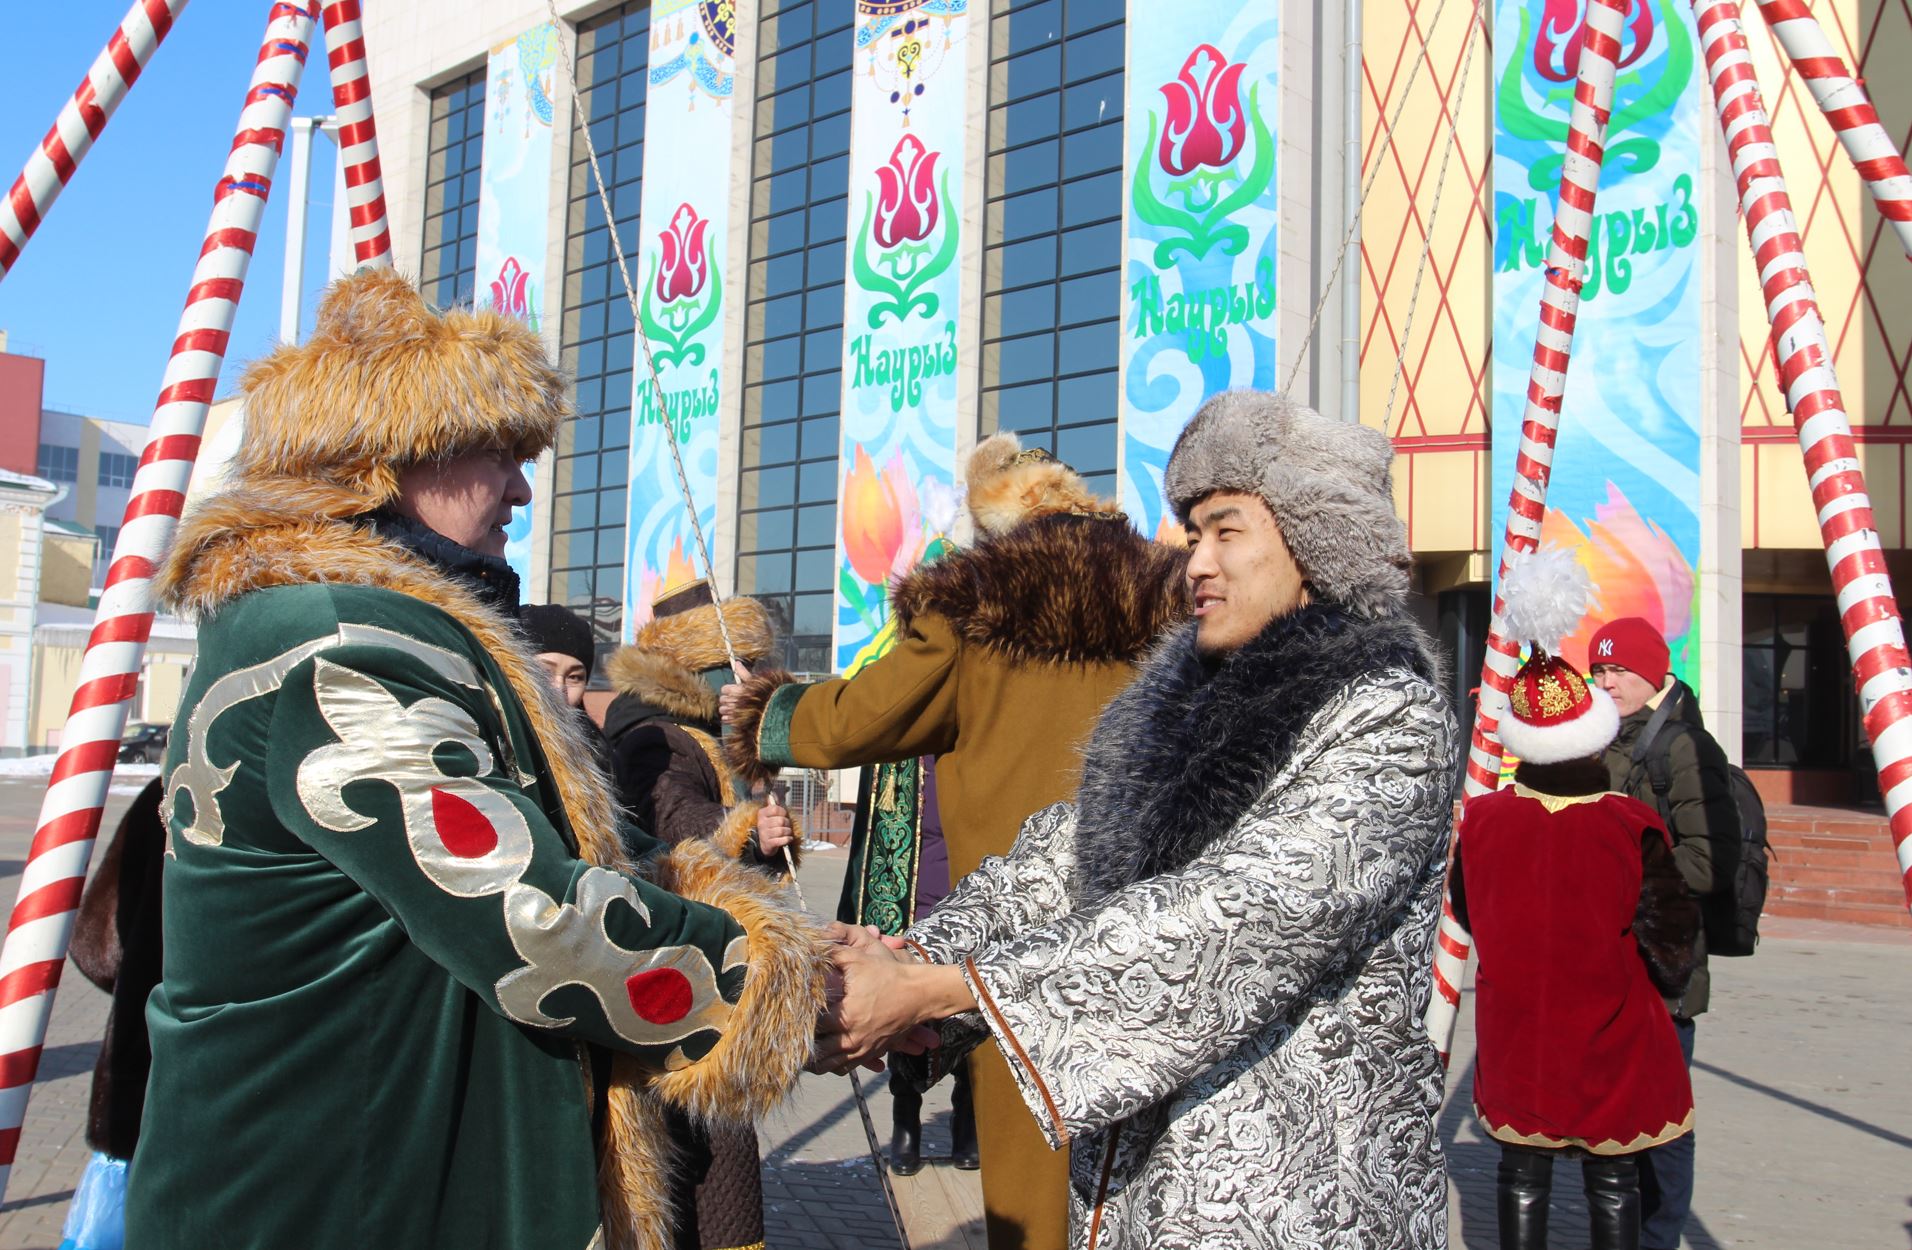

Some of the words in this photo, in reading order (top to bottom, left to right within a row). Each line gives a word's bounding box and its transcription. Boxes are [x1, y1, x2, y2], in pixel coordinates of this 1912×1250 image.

[1499, 173, 1698, 302] Нурыз
[1131, 256, 1276, 365] Наурыз
[850, 319, 958, 413] Наурыз
[1597, 638, 1614, 657] NY
